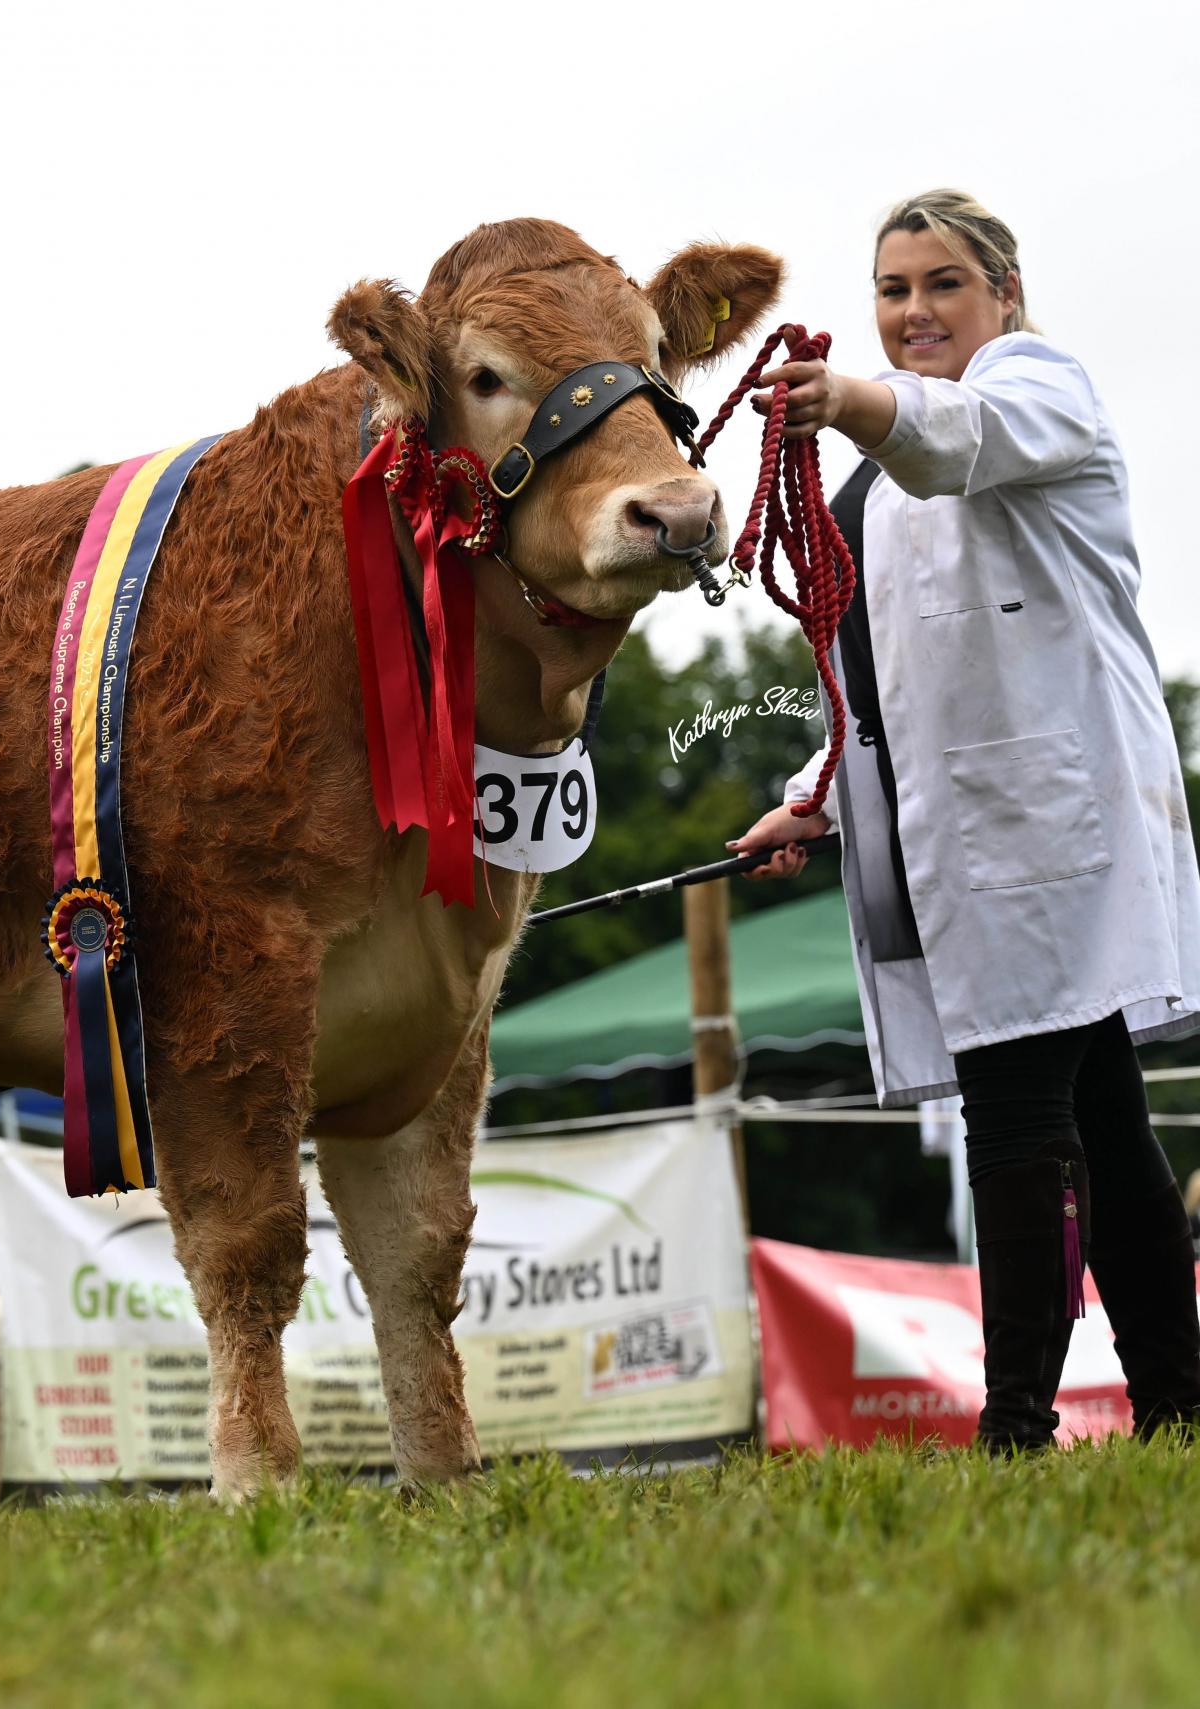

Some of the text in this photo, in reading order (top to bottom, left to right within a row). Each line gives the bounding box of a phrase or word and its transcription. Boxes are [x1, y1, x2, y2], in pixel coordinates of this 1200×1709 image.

[81, 648, 97, 686] 2023
[106, 605, 131, 661] Limousin
[52, 580, 87, 770] Reserve Supreme Champion
[100, 664, 118, 764] Championship
[473, 768, 588, 845] 379
[506, 1256, 603, 1310] Stores
[612, 1240, 662, 1296] Ltd
